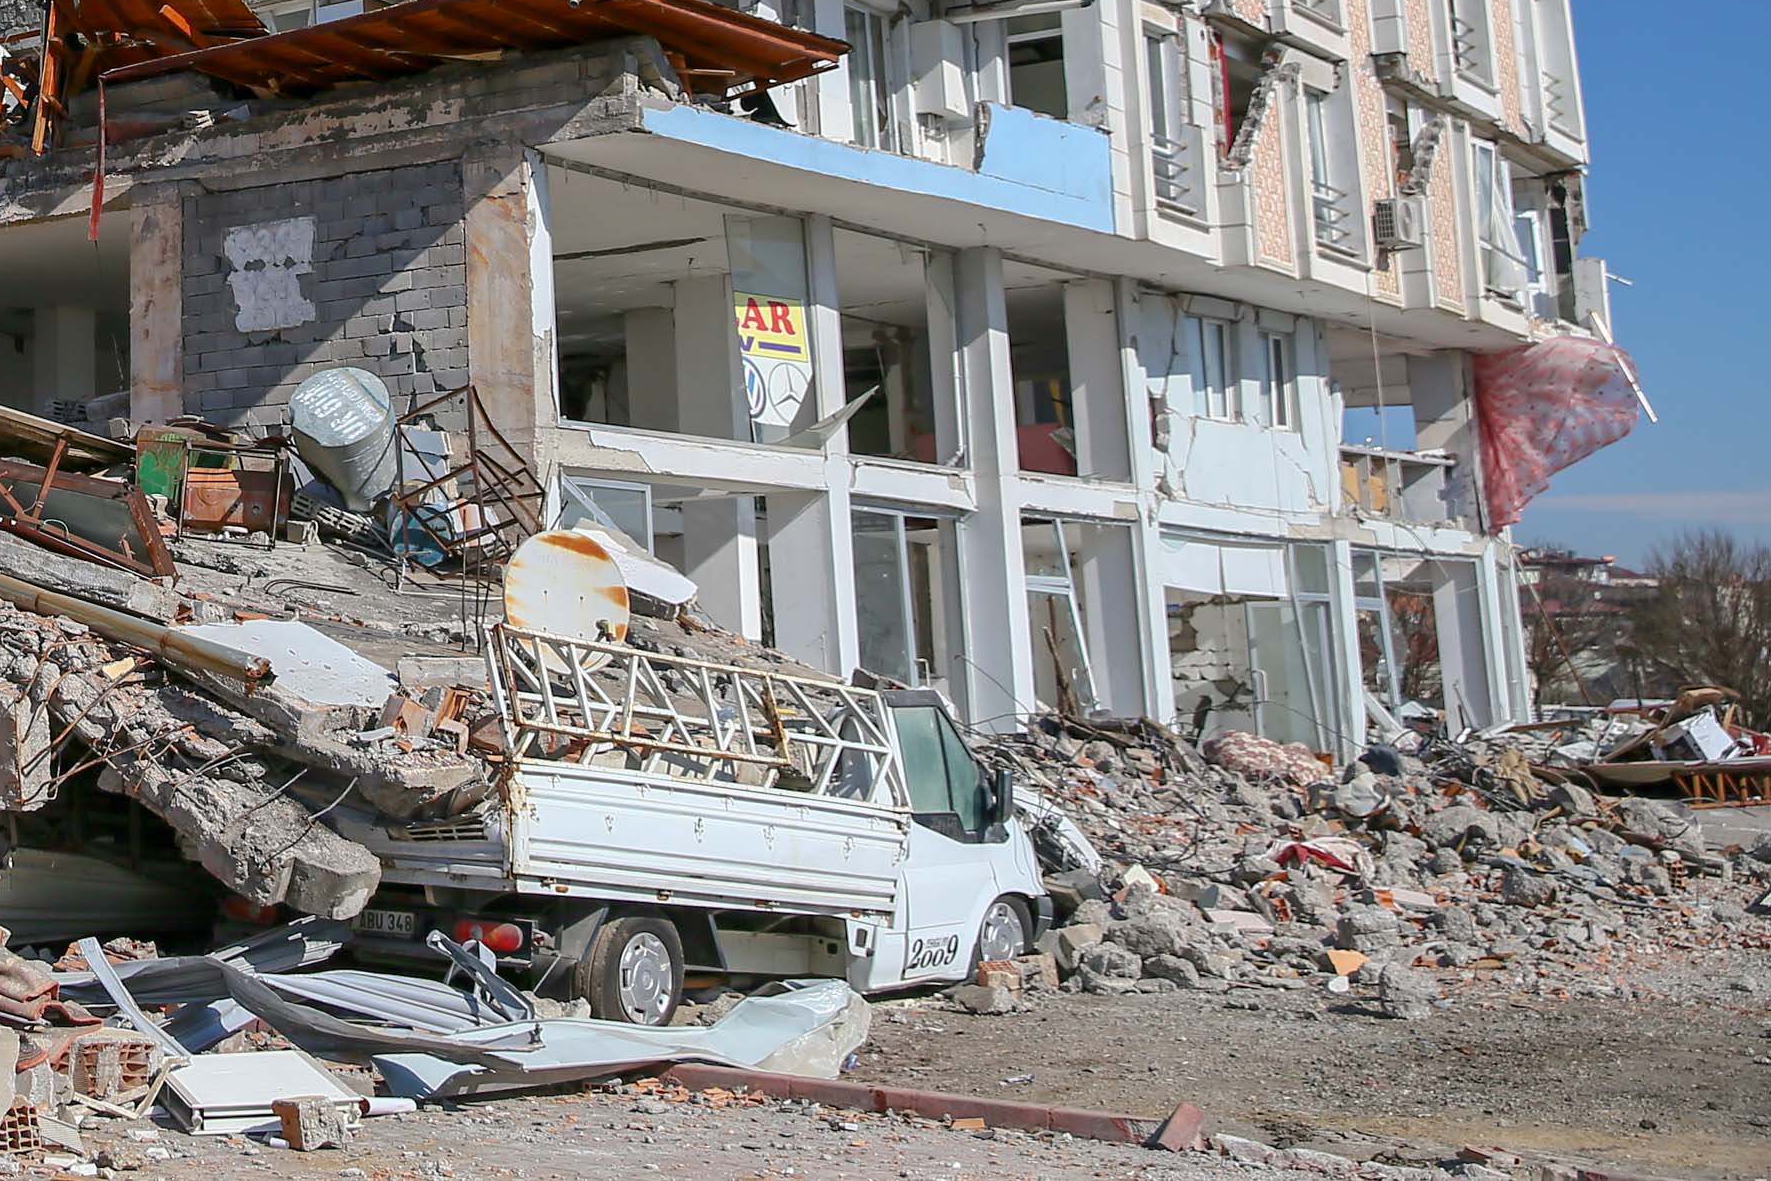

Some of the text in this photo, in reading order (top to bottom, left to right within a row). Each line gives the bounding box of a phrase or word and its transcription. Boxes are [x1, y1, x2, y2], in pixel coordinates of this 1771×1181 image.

[736, 297, 796, 335] AR
[388, 913, 412, 932] 348
[906, 934, 959, 969] 2009
